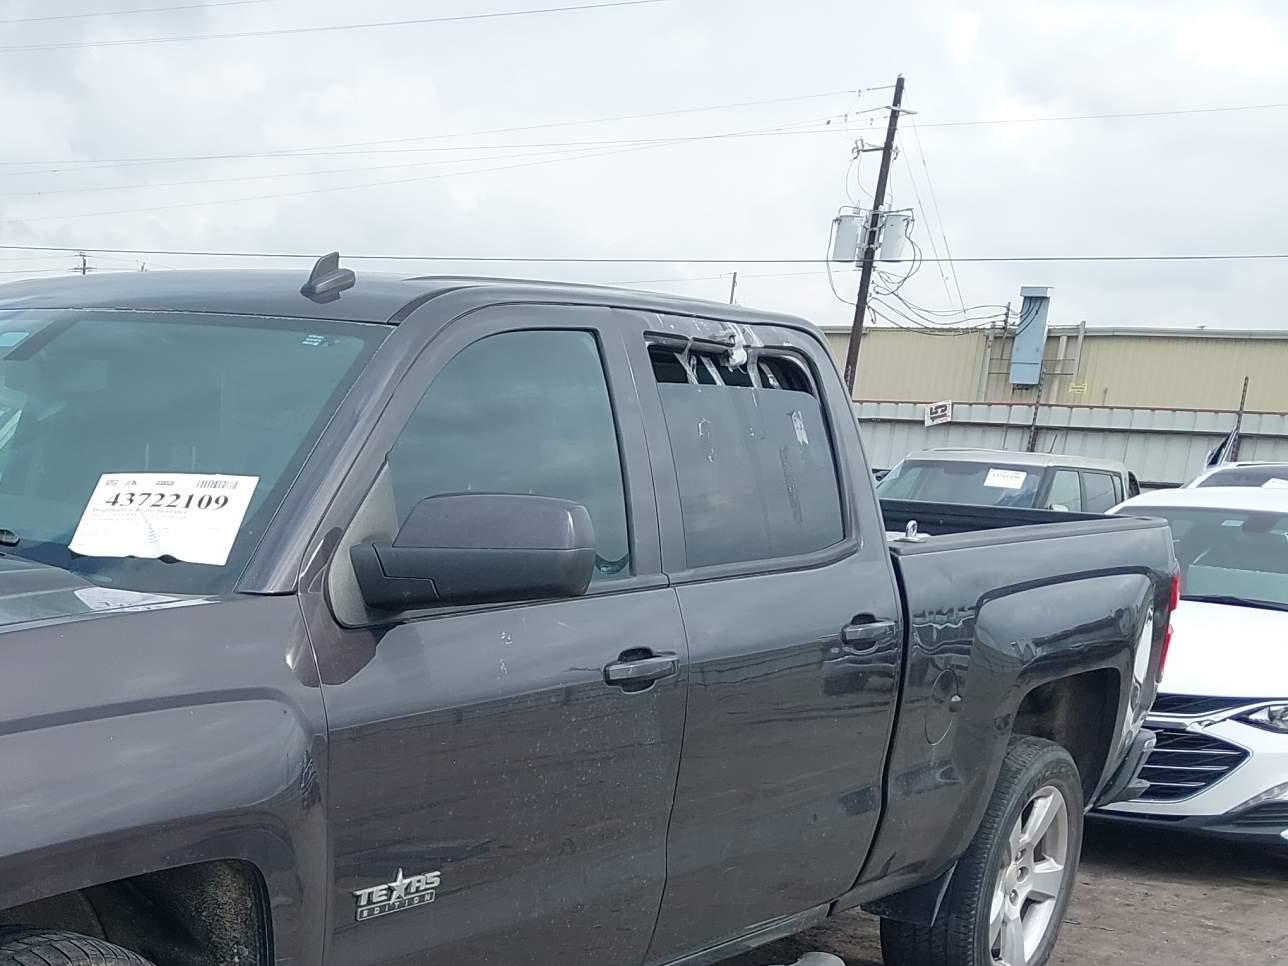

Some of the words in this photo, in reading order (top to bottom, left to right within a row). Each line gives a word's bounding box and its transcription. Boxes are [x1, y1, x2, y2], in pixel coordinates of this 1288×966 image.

[105, 492, 229, 510] 43722109
[353, 867, 442, 906] TEXAS
[362, 893, 432, 918] EDITION
